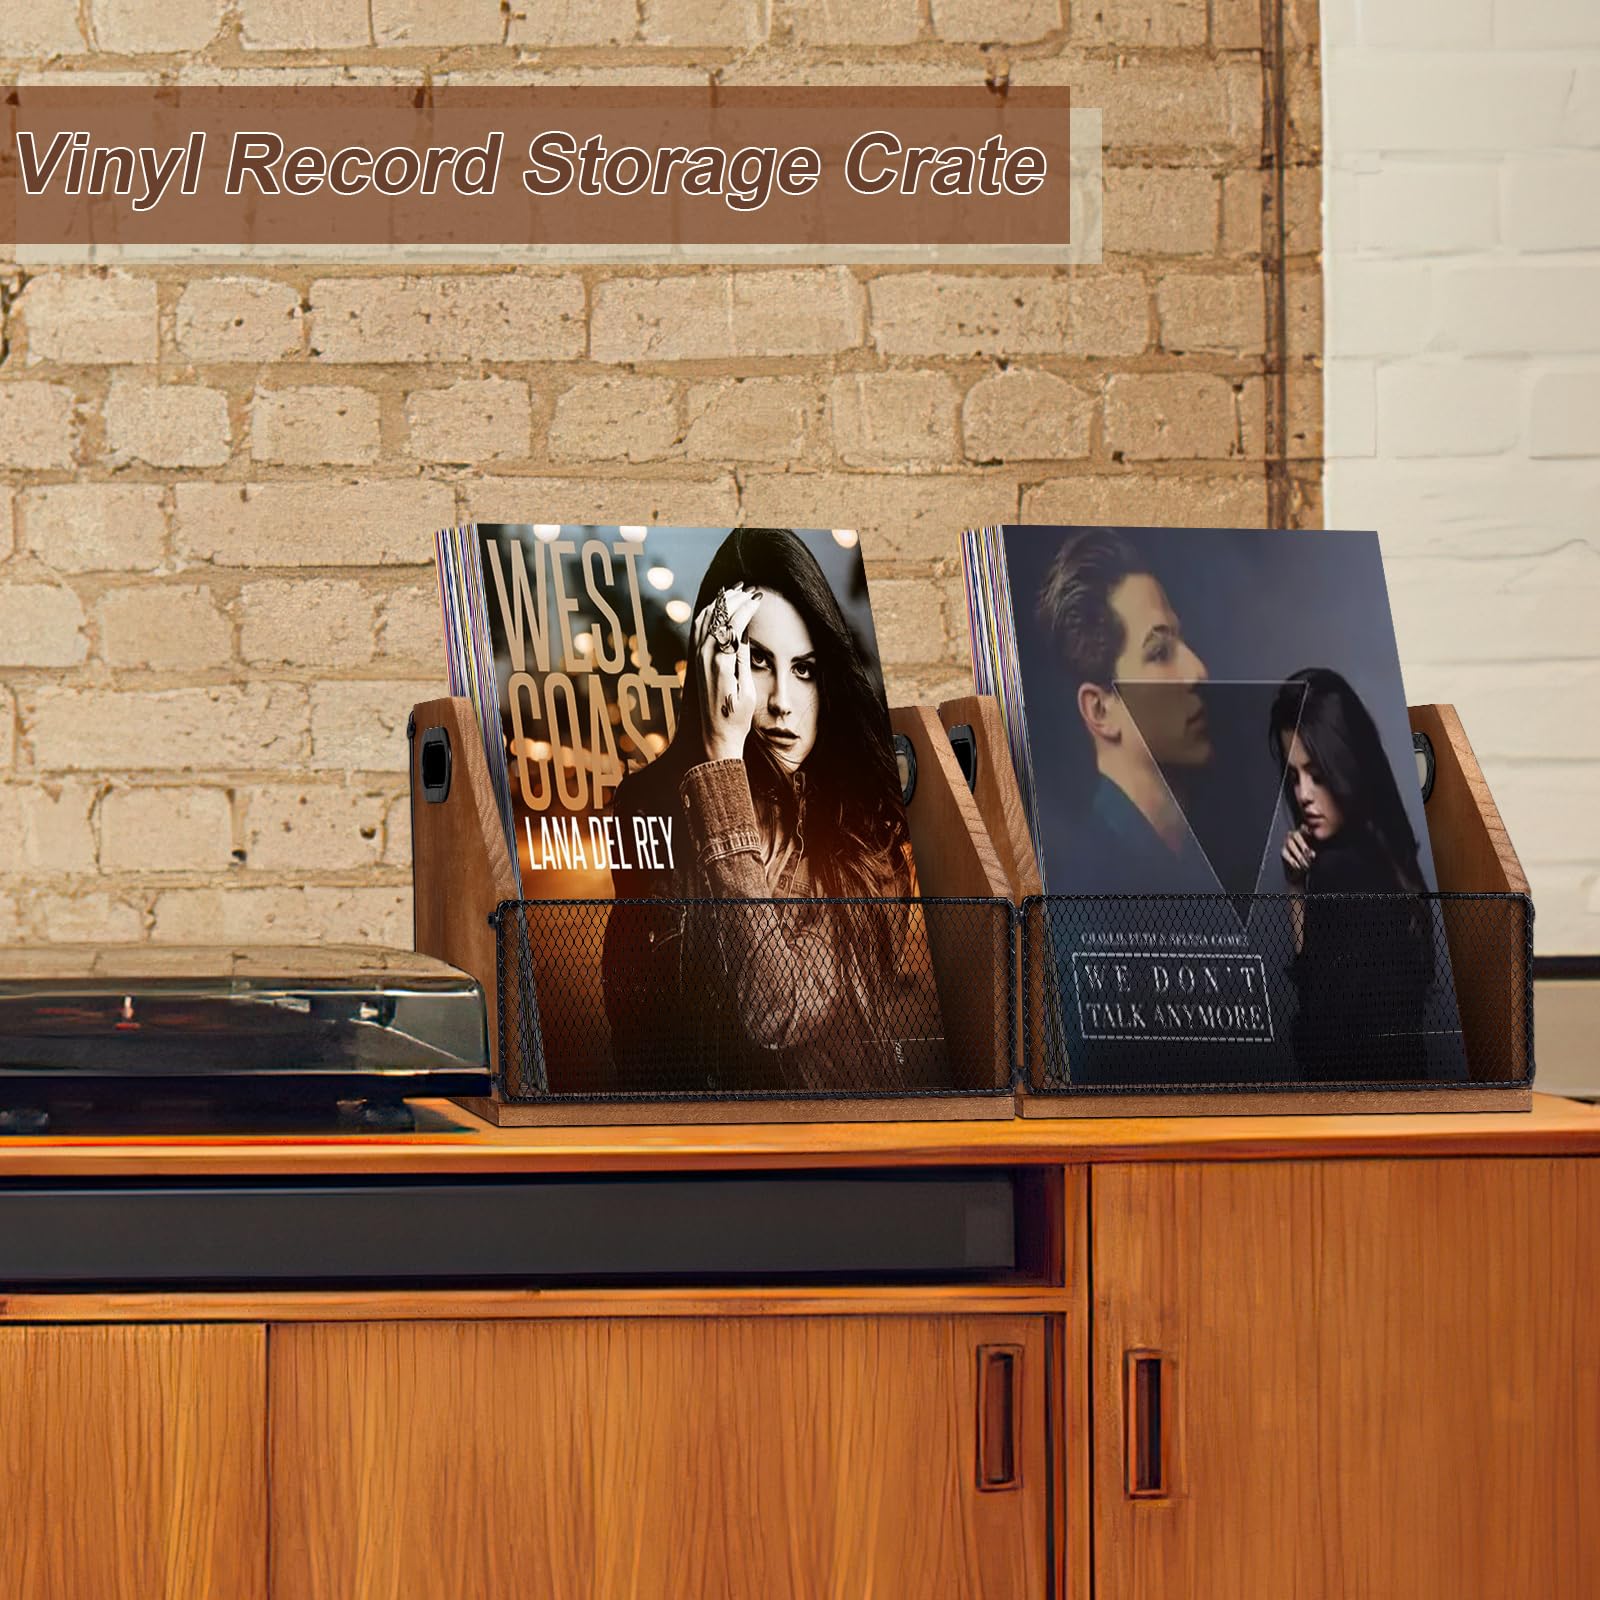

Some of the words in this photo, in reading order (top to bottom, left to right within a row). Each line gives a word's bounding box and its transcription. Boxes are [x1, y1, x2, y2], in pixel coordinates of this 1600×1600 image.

[486, 539, 650, 675] WEST
[525, 816, 587, 871] LANA
[588, 816, 632, 871] DEL
[632, 816, 674, 871] REY
[1085, 965, 1131, 992] WE
[1153, 965, 1256, 993] DON'T
[1086, 1003, 1146, 1029] TALK
[1154, 1003, 1265, 1030] ANYMORE
